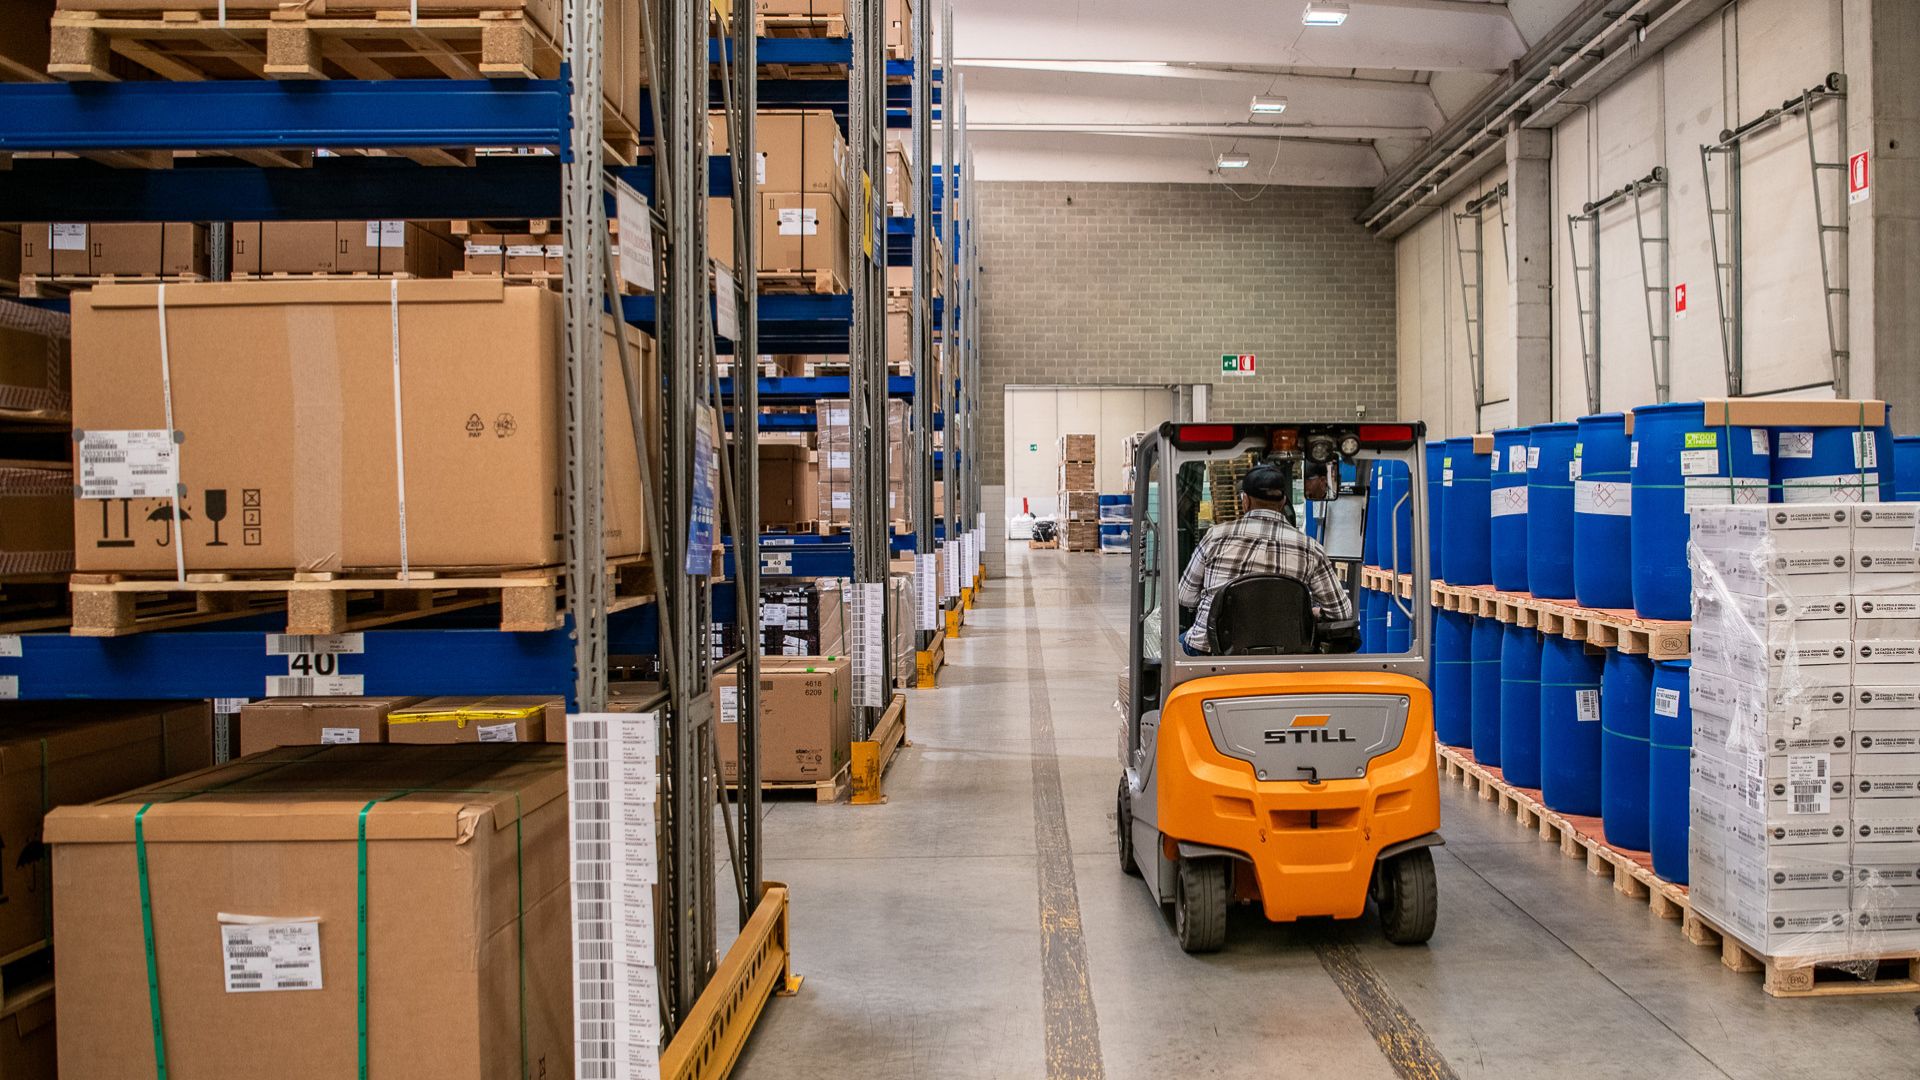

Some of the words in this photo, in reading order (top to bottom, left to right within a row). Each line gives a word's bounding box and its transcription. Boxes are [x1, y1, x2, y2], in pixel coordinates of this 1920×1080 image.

[291, 653, 335, 675] 40
[1792, 716, 1801, 730] P
[1264, 728, 1356, 744] STILL
